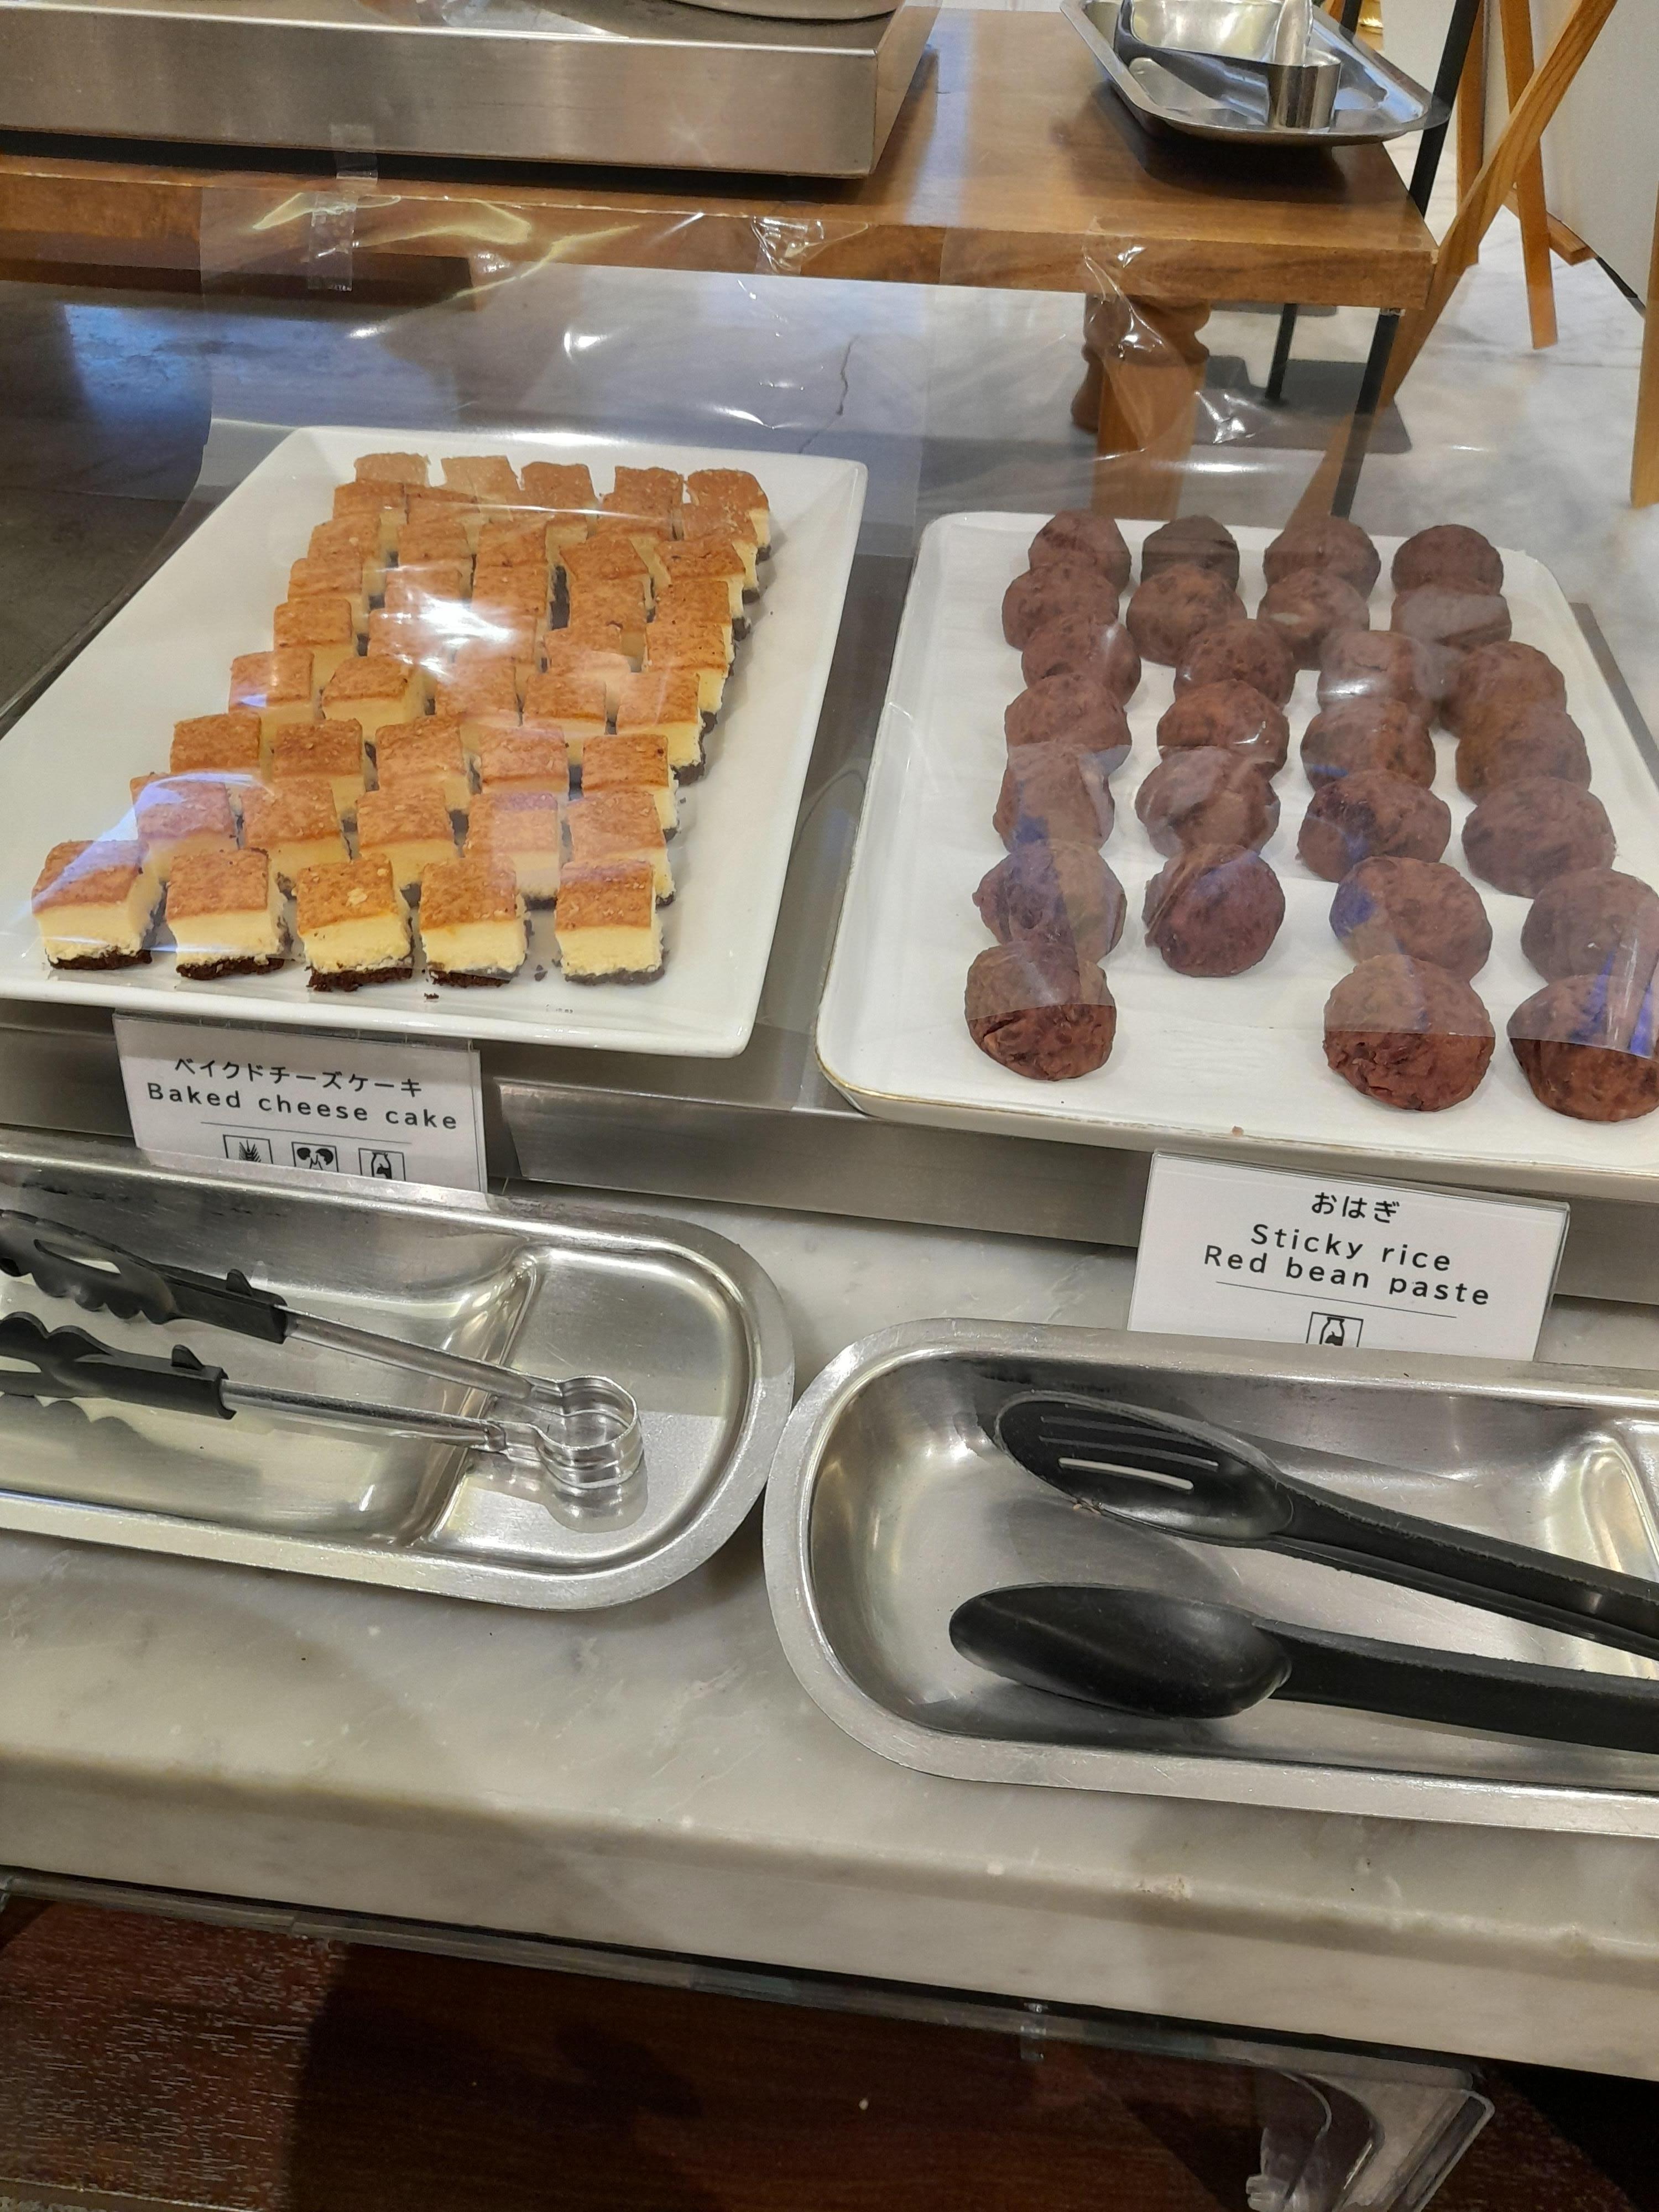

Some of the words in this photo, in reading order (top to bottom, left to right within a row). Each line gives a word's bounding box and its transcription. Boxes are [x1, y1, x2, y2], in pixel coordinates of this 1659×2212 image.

[175, 1058, 422, 1097] ベイクドチーズケーキ
[147, 1082, 241, 1108] Baked
[258, 1094, 368, 1121] cheese
[385, 1108, 456, 1130] cake
[1312, 1192, 1401, 1224] おはぎ
[1250, 1224, 1364, 1260] Sticky
[1381, 1244, 1451, 1271] rice
[1204, 1245, 1267, 1274] Red
[1286, 1256, 1369, 1288] bean
[1389, 1277, 1489, 1306] paste
